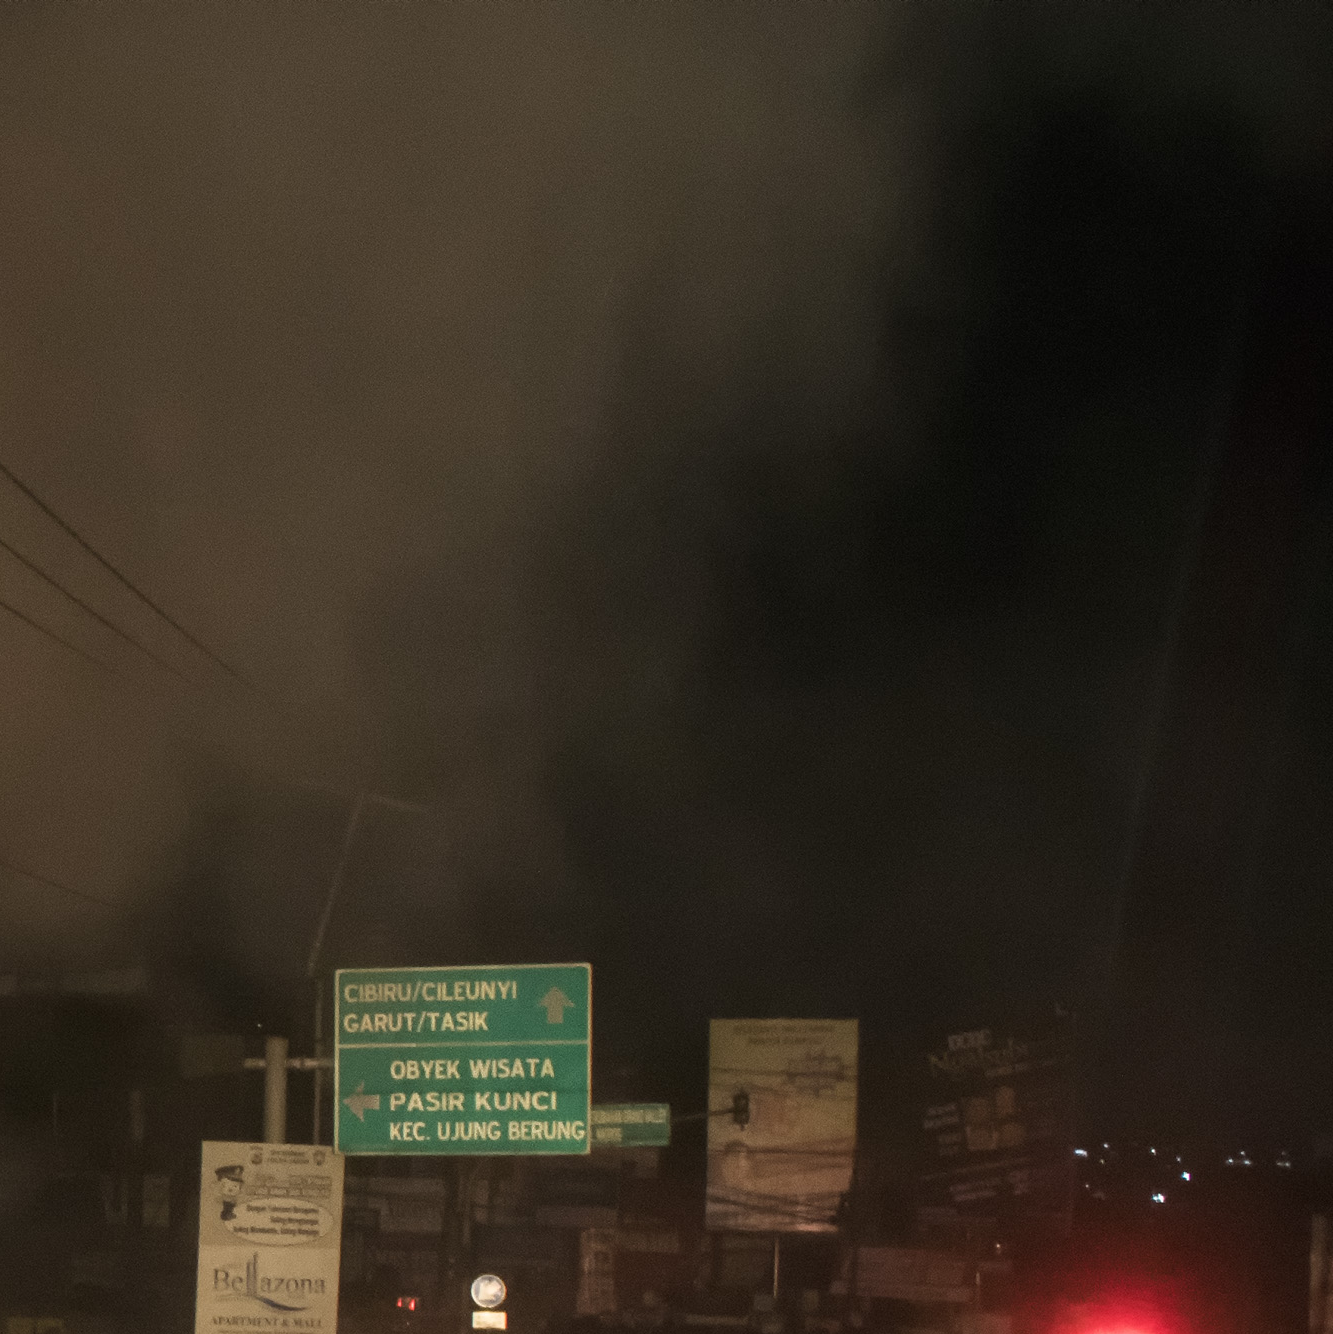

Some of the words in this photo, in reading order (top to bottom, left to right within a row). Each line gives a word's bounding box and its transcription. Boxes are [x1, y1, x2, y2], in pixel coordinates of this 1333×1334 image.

[343, 980, 517, 1003] CIBIRU/CILEUNYI
[343, 1011, 489, 1033] GARUT/TASIK
[390, 1059, 461, 1080] OBYEK
[469, 1058, 555, 1079] WISATA
[389, 1091, 465, 1112] PASIR
[474, 1090, 558, 1111] KUNCI
[389, 1121, 431, 1141] KEC.
[437, 1120, 502, 1141] UJUNG
[508, 1120, 586, 1141] BERUNG
[213, 1254, 326, 1296] Bellazona
